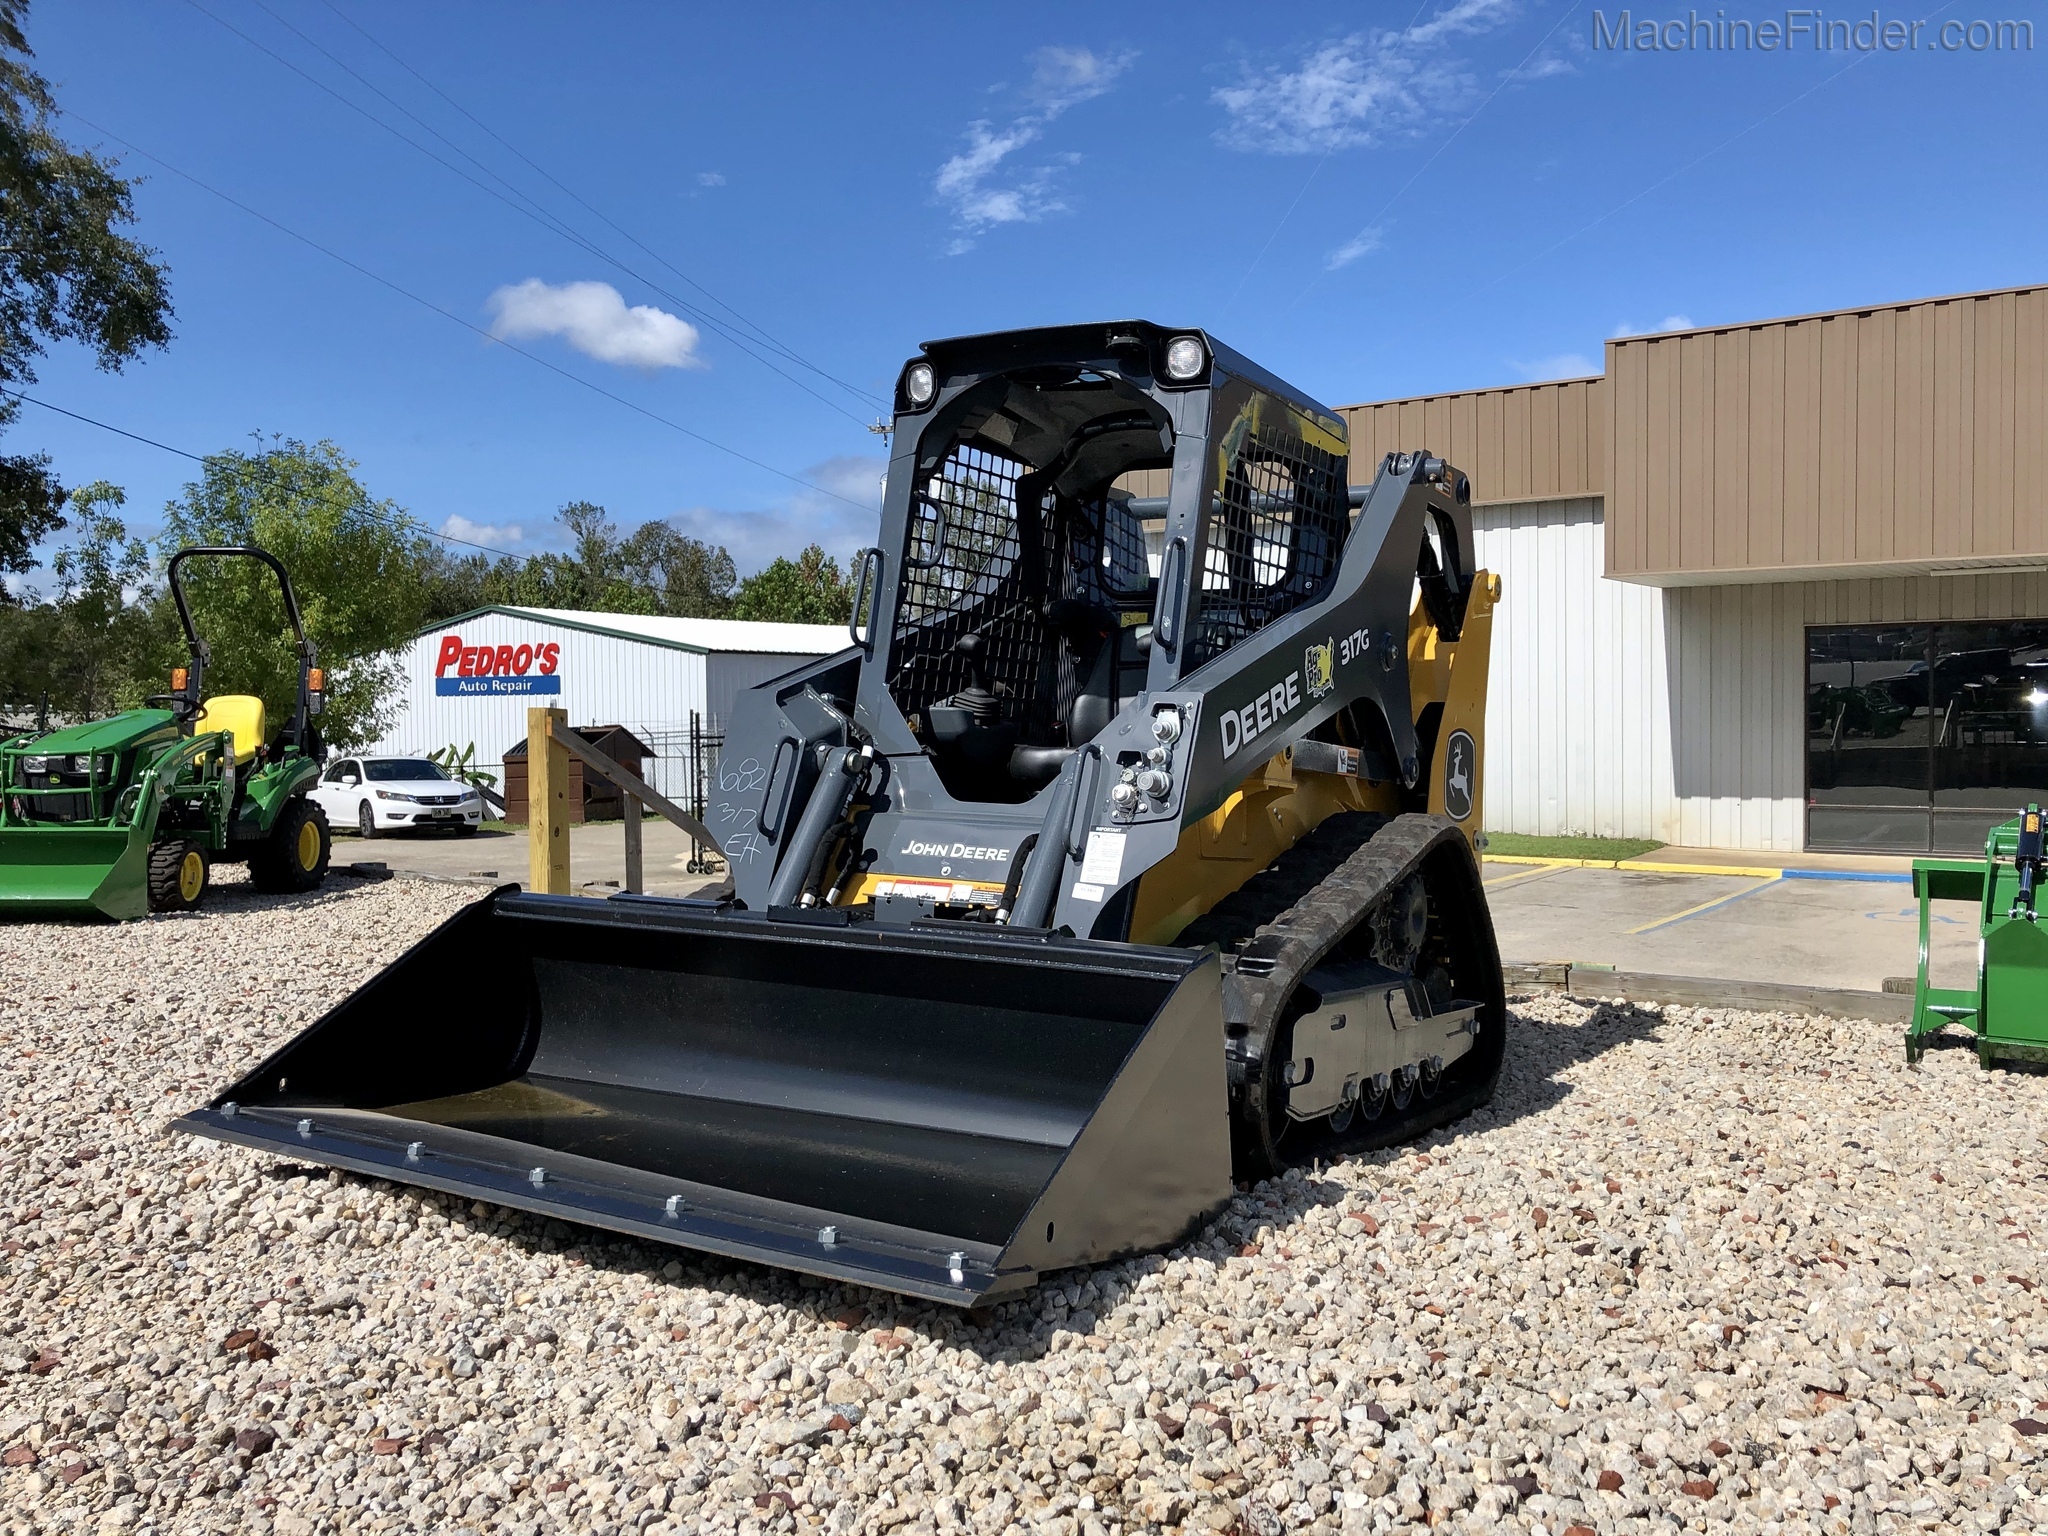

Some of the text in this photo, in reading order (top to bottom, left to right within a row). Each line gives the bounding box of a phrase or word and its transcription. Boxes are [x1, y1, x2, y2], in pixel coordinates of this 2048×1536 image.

[435, 636, 560, 677] PEDRO'S
[1340, 628, 1370, 666] 317G
[458, 680, 533, 693] Auto Repair
[1219, 670, 1301, 760] DEERE
[717, 802, 758, 829] 317
[901, 840, 1010, 862] JOHN DEERE
